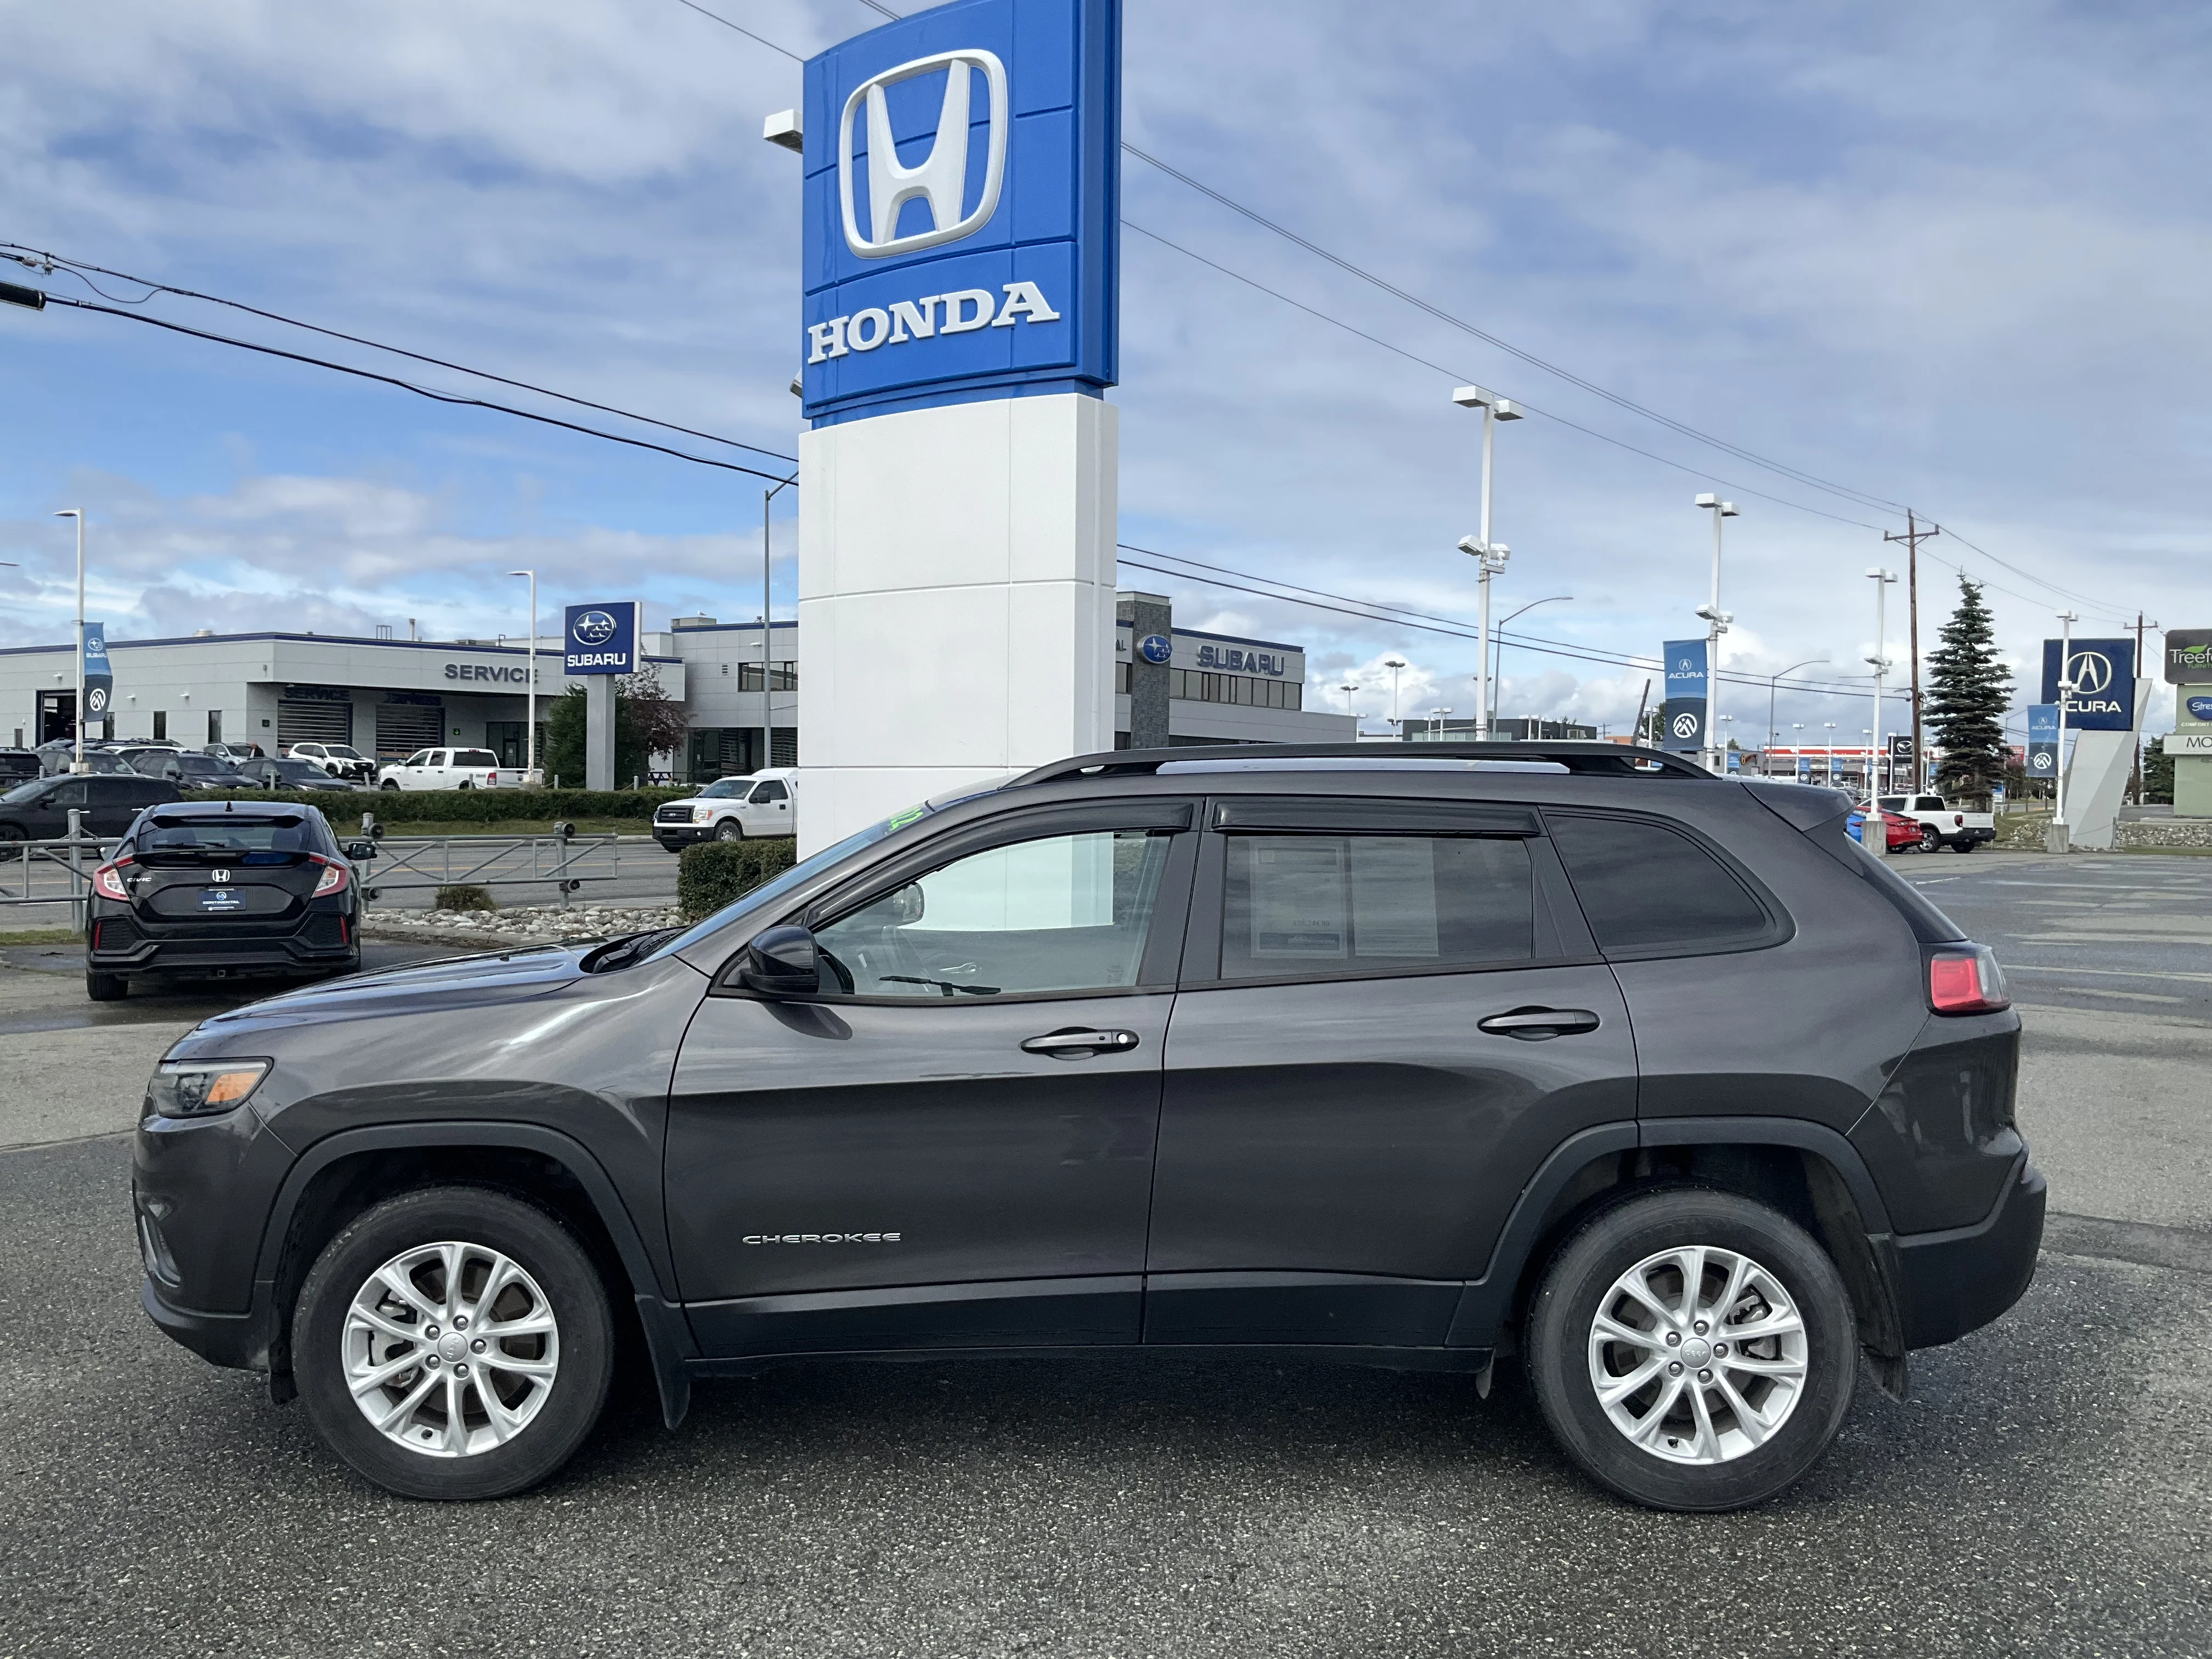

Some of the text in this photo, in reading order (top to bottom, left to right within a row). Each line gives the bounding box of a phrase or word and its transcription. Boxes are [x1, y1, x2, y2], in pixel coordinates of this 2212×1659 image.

[808, 281, 1060, 364] HONDA
[567, 653, 627, 668] SUBARU
[1197, 645, 1285, 676] SUBARU
[2169, 647, 2212, 663] Treef
[444, 664, 538, 684] SERVICE
[742, 1232, 901, 1244] CHEROKEE
